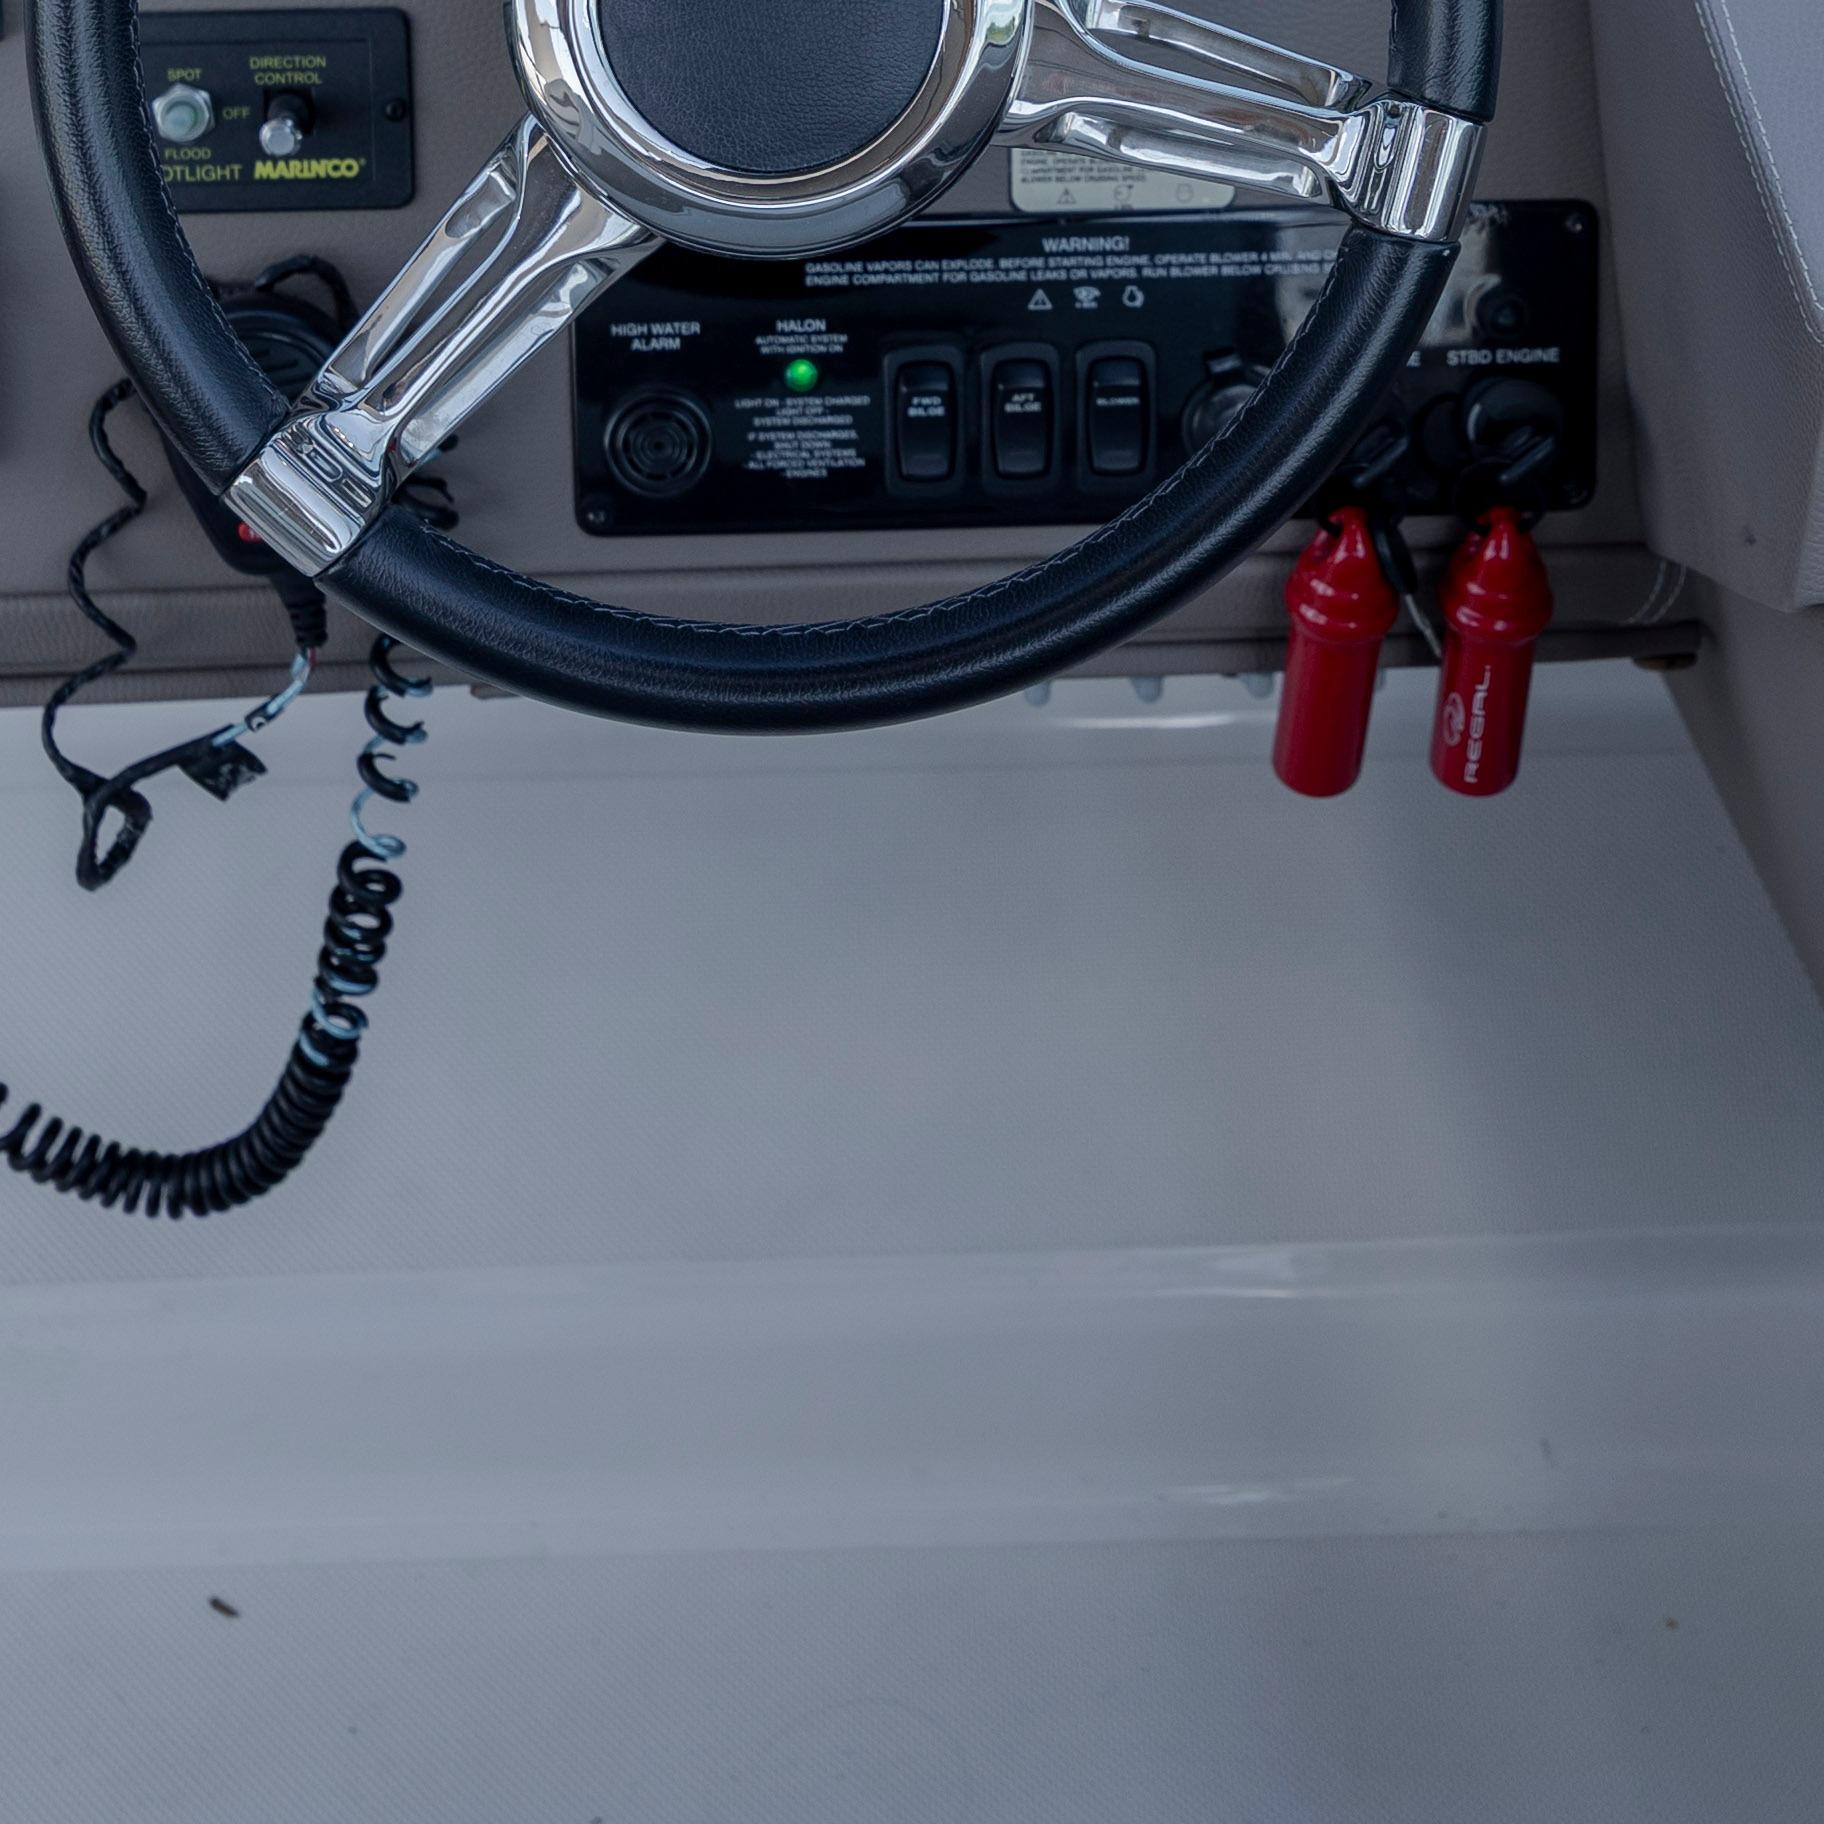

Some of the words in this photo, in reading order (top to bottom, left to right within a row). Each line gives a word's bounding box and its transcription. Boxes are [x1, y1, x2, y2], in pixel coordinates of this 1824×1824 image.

[249, 55, 327, 70] DIRECTION
[167, 68, 202, 82] SPOT
[254, 71, 324, 86] CONTROL
[222, 106, 251, 121] OFF
[164, 147, 212, 161] FLOOD
[161, 163, 244, 182] OTLIGHT
[254, 157, 360, 181] MARINCO
[1041, 236, 1131, 254] WARNING!
[805, 261, 863, 274] GASOLINE
[866, 260, 912, 273] VAPORS
[914, 259, 939, 271] CAN
[999, 257, 1044, 269] BEFORE
[1047, 255, 1104, 268] STARTING
[1154, 253, 1207, 266] OPERATE
[1209, 252, 1259, 264] BLOWER
[805, 274, 849, 287] ENGINE
[852, 272, 939, 286] COMPARTMENT
[942, 271, 968, 283] FOR
[970, 270, 1027, 283] GASOLINE
[1030, 269, 1067, 281] LEAKS
[1070, 268, 1088, 280] OR
[1140, 266, 1168, 278] RUN
[1169, 265, 1218, 278] BLOWER
[1220, 264, 1262, 277] BELOW
[610, 322, 648, 337] HIGH
[650, 321, 702, 336] WATER
[776, 319, 827, 334] HALON
[630, 337, 681, 352] ALARM
[755, 335, 809, 347] AUTOMATIC
[810, 333, 848, 346] SYSTEM
[785, 343, 825, 355] IGNITION
[1446, 348, 1493, 367] STBD
[1495, 346, 1561, 365] ENGINE
[734, 397, 762, 409] LIGHT
[824, 395, 871, 407] CHARGED
[753, 415, 791, 427] SYSTEM
[792, 414, 854, 426] DISCHARGED
[758, 430, 796, 443] SYSTEM
